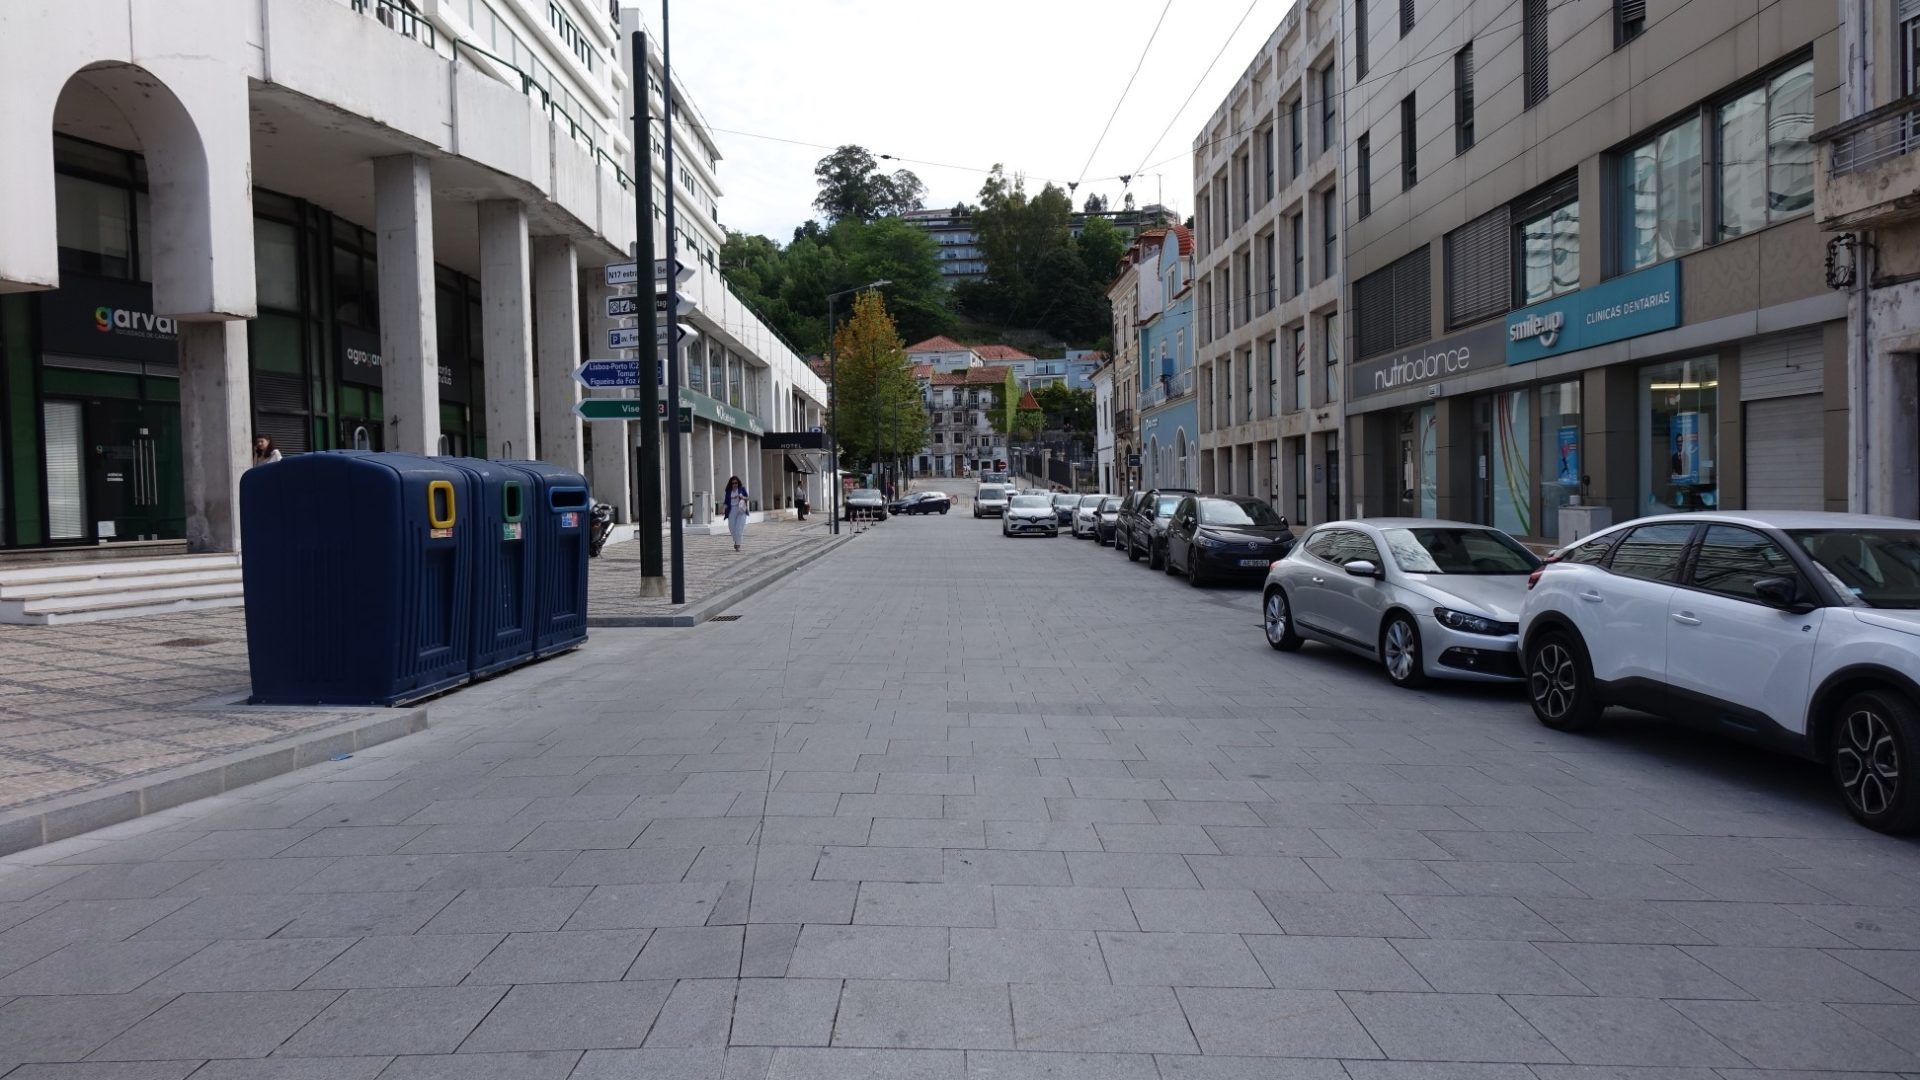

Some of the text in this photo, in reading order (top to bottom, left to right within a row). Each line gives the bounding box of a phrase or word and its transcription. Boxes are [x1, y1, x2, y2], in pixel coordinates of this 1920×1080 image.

[608, 271, 621, 279] N17
[589, 362, 627, 371] Lisboa-Porto
[1375, 347, 1470, 390] nutribalance
[625, 377, 637, 385] Foz
[622, 404, 640, 413] Vise
